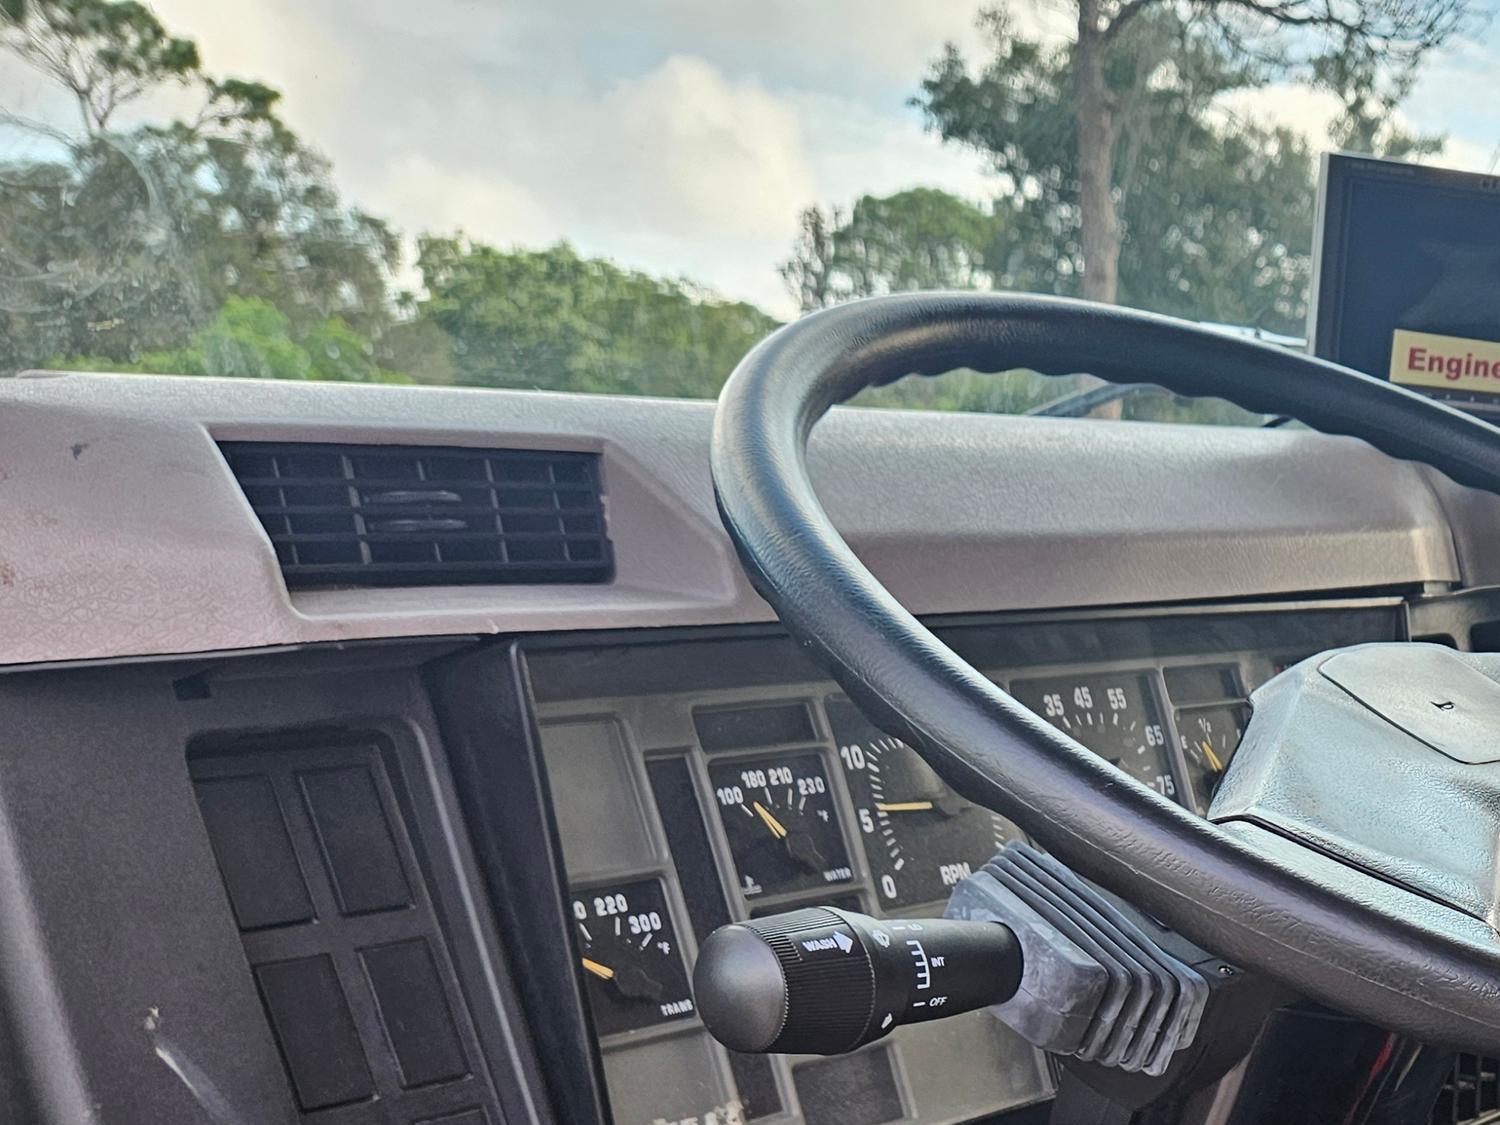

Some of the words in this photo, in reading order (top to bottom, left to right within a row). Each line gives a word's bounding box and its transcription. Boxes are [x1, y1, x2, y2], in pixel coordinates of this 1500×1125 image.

[1043, 694, 1065, 717] 35
[1073, 686, 1094, 709] 45
[1106, 687, 1128, 710] 55
[1144, 724, 1165, 747] 65
[840, 744, 866, 771] 10
[768, 766, 793, 785] 210
[797, 776, 826, 796] 230
[1155, 774, 1176, 796] 75
[717, 786, 744, 806] 100
[858, 808, 875, 834] 5
[823, 867, 852, 882] WATER
[939, 862, 972, 886] RPM
[881, 874, 897, 899] 0
[593, 893, 629, 917] 220
[628, 911, 662, 935] 300
[802, 936, 837, 952] WASH
[931, 956, 946, 968] INT
[660, 999, 693, 1016] TRANS
[929, 996, 948, 1007] OFF
